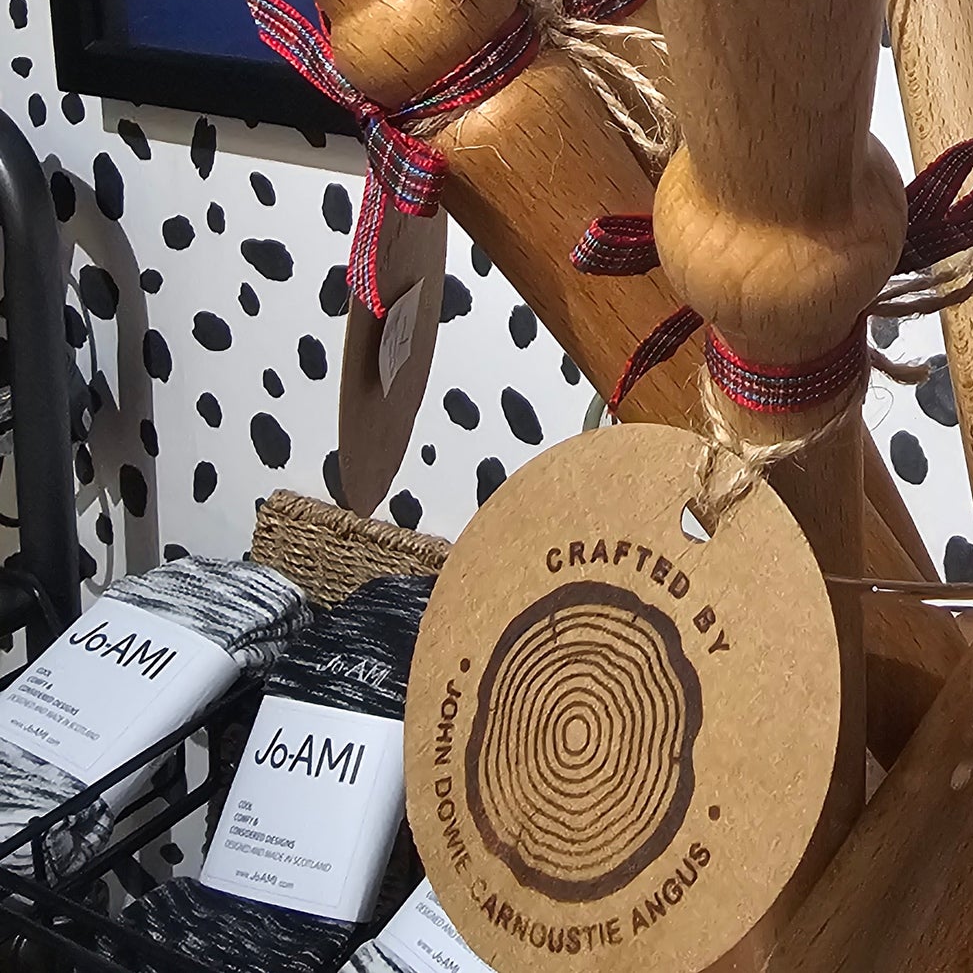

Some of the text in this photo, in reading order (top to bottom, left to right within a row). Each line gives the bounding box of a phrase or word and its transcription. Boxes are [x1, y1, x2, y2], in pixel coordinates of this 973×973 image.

[545, 539, 731, 657] CRAFTED BY
[434, 678, 711, 955] JOHN DOWIE CARNOUSTIE ANGUS
